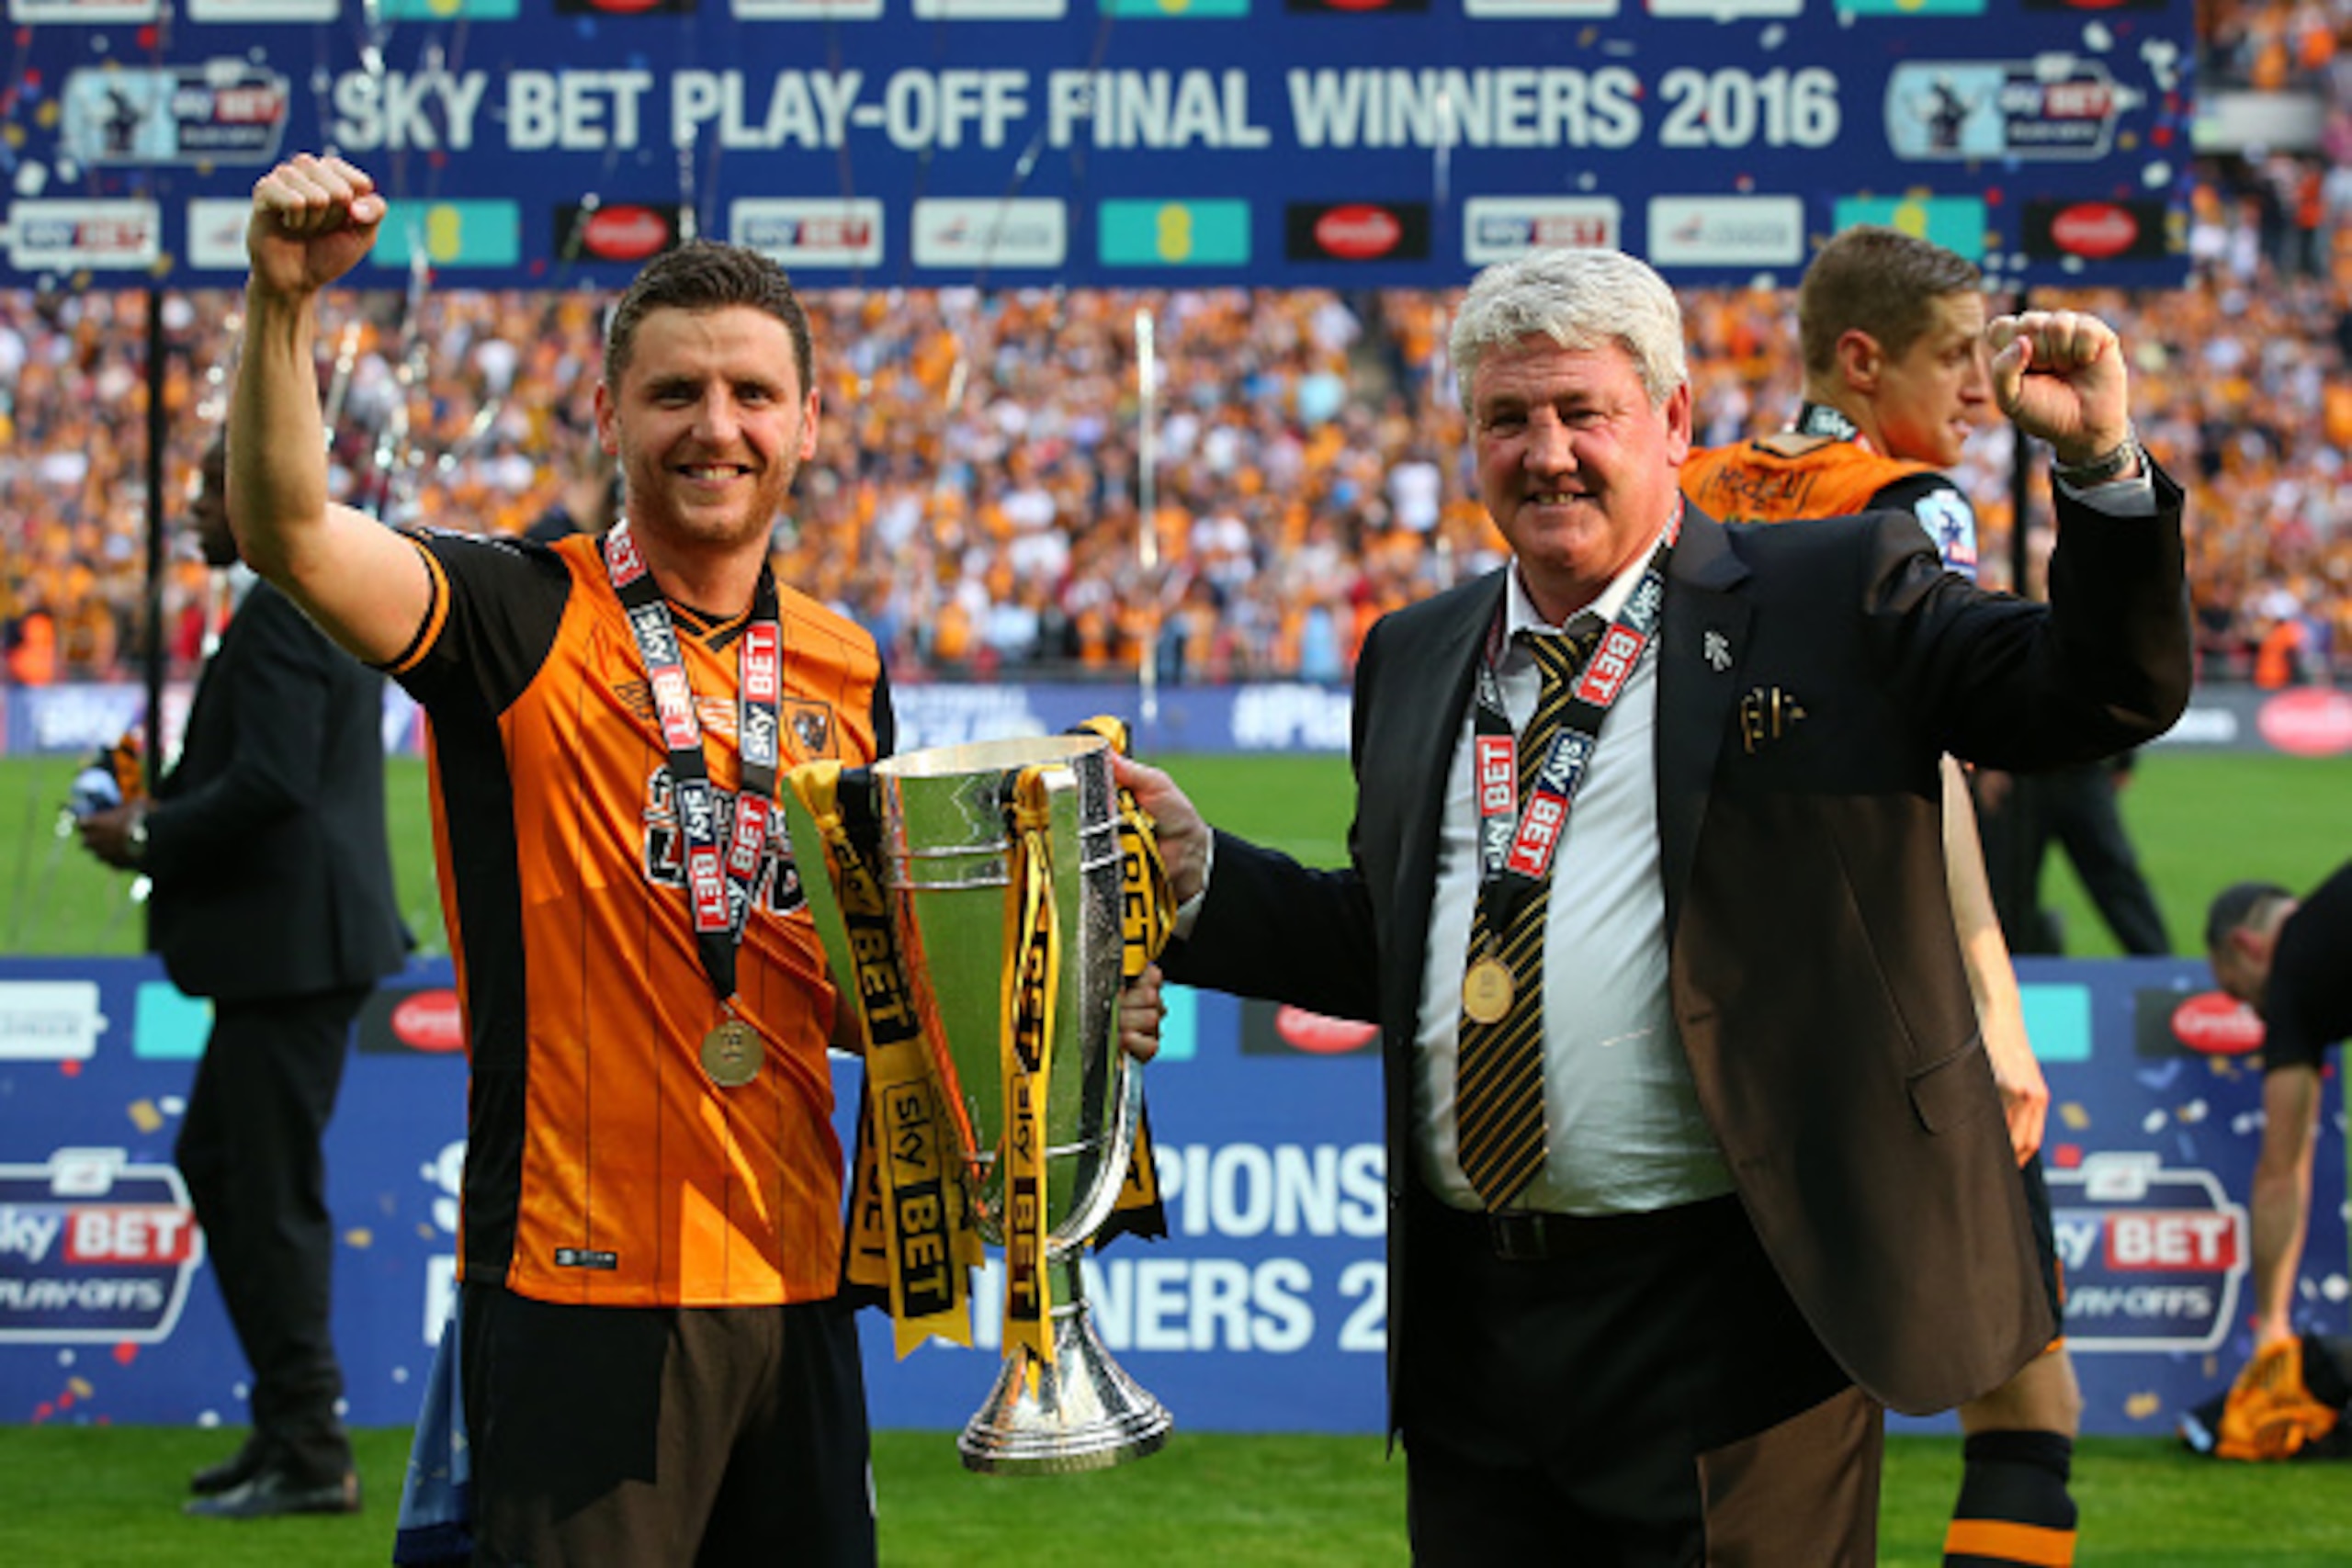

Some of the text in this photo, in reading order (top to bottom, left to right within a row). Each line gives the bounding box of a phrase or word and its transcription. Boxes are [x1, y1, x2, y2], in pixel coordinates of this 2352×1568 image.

[334, 67, 1840, 151] SKY BET PLAY-OFF FINAL WINNERS 2016
[636, 613, 693, 733] sky BET
[746, 631, 776, 757] sky BET
[1591, 630, 1638, 699] BET
[1482, 741, 1510, 810] BET
[1516, 739, 1583, 870] sky BET
[684, 790, 726, 920] sky BET
[729, 801, 764, 872] BET
[851, 927, 910, 1029] BET
[0, 1207, 184, 1263] ky BET
[895, 1095, 948, 1302] sky BET
[2114, 1217, 2230, 1265] BET
[1013, 1193, 1039, 1309] BET
